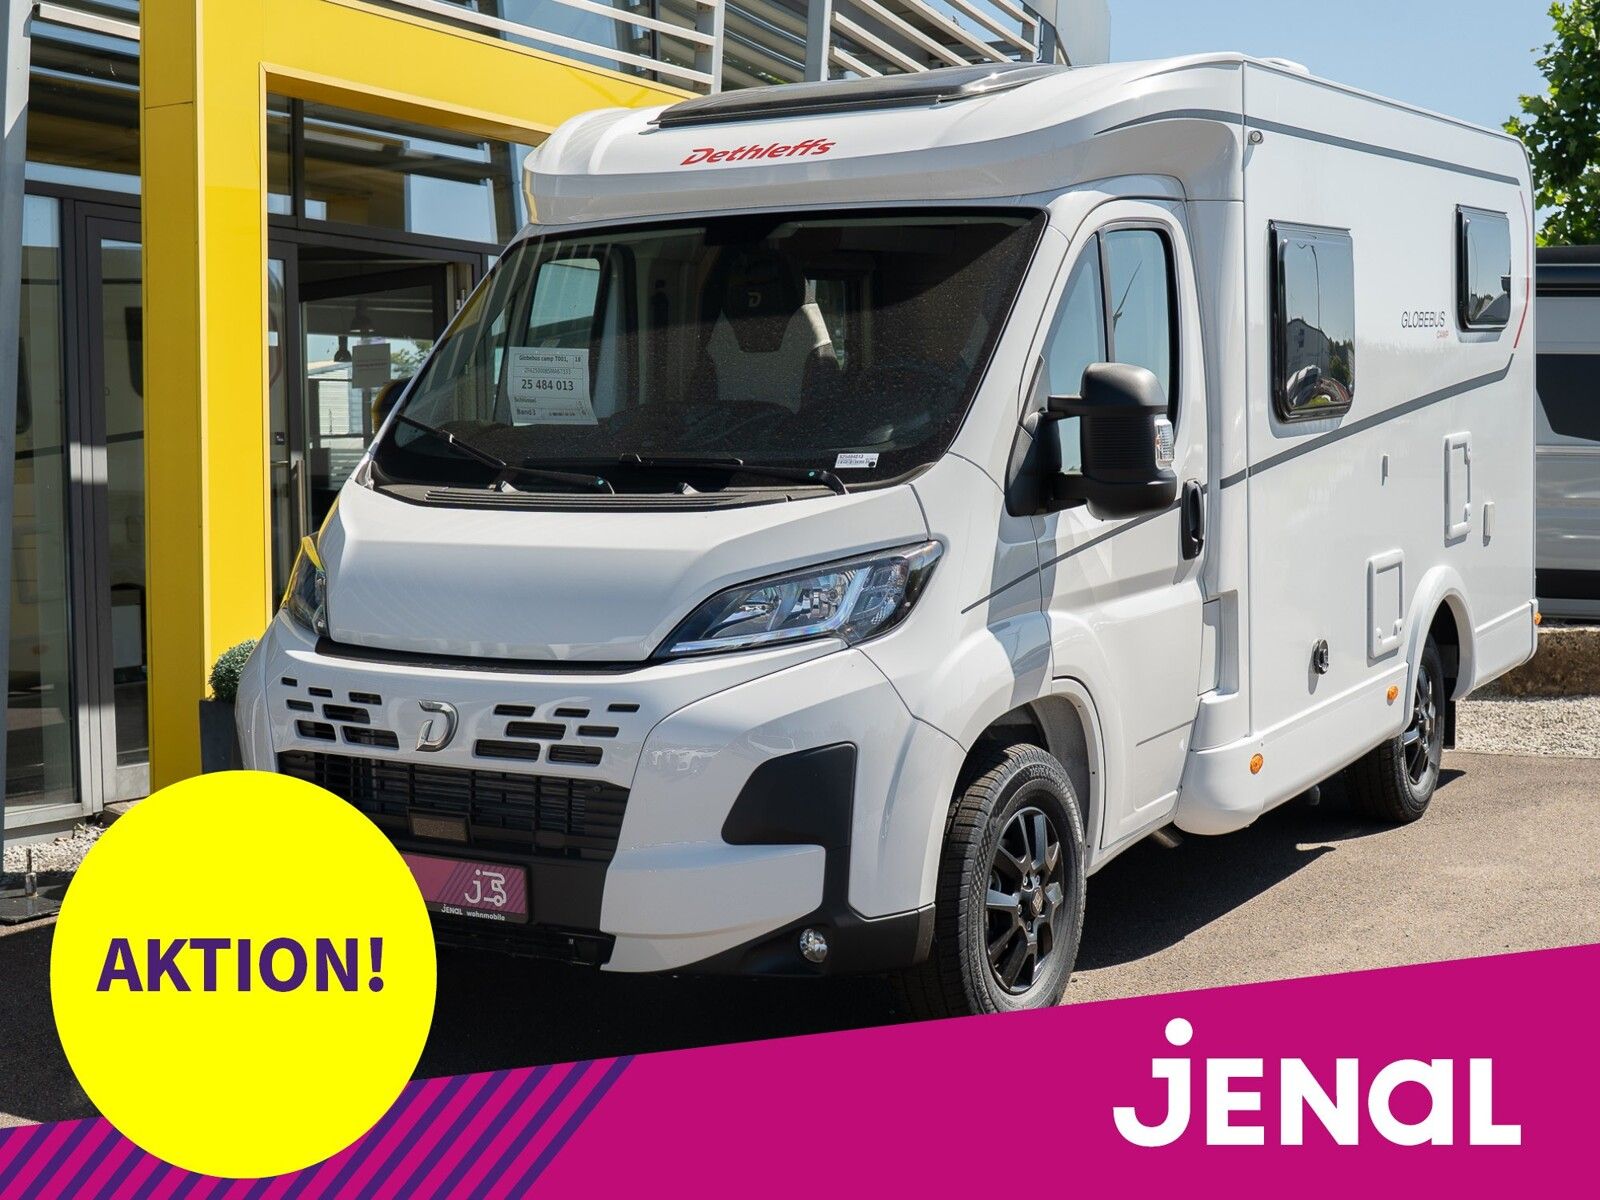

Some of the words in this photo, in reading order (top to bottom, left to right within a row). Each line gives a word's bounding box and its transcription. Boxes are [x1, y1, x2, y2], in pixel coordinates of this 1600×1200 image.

[680, 138, 836, 166] Dethleffs
[1400, 311, 1446, 328] GLOBEBUS
[521, 379, 533, 390] 25
[536, 380, 554, 390] 484
[556, 380, 574, 391] 013
[466, 911, 506, 921] wohnmobile
